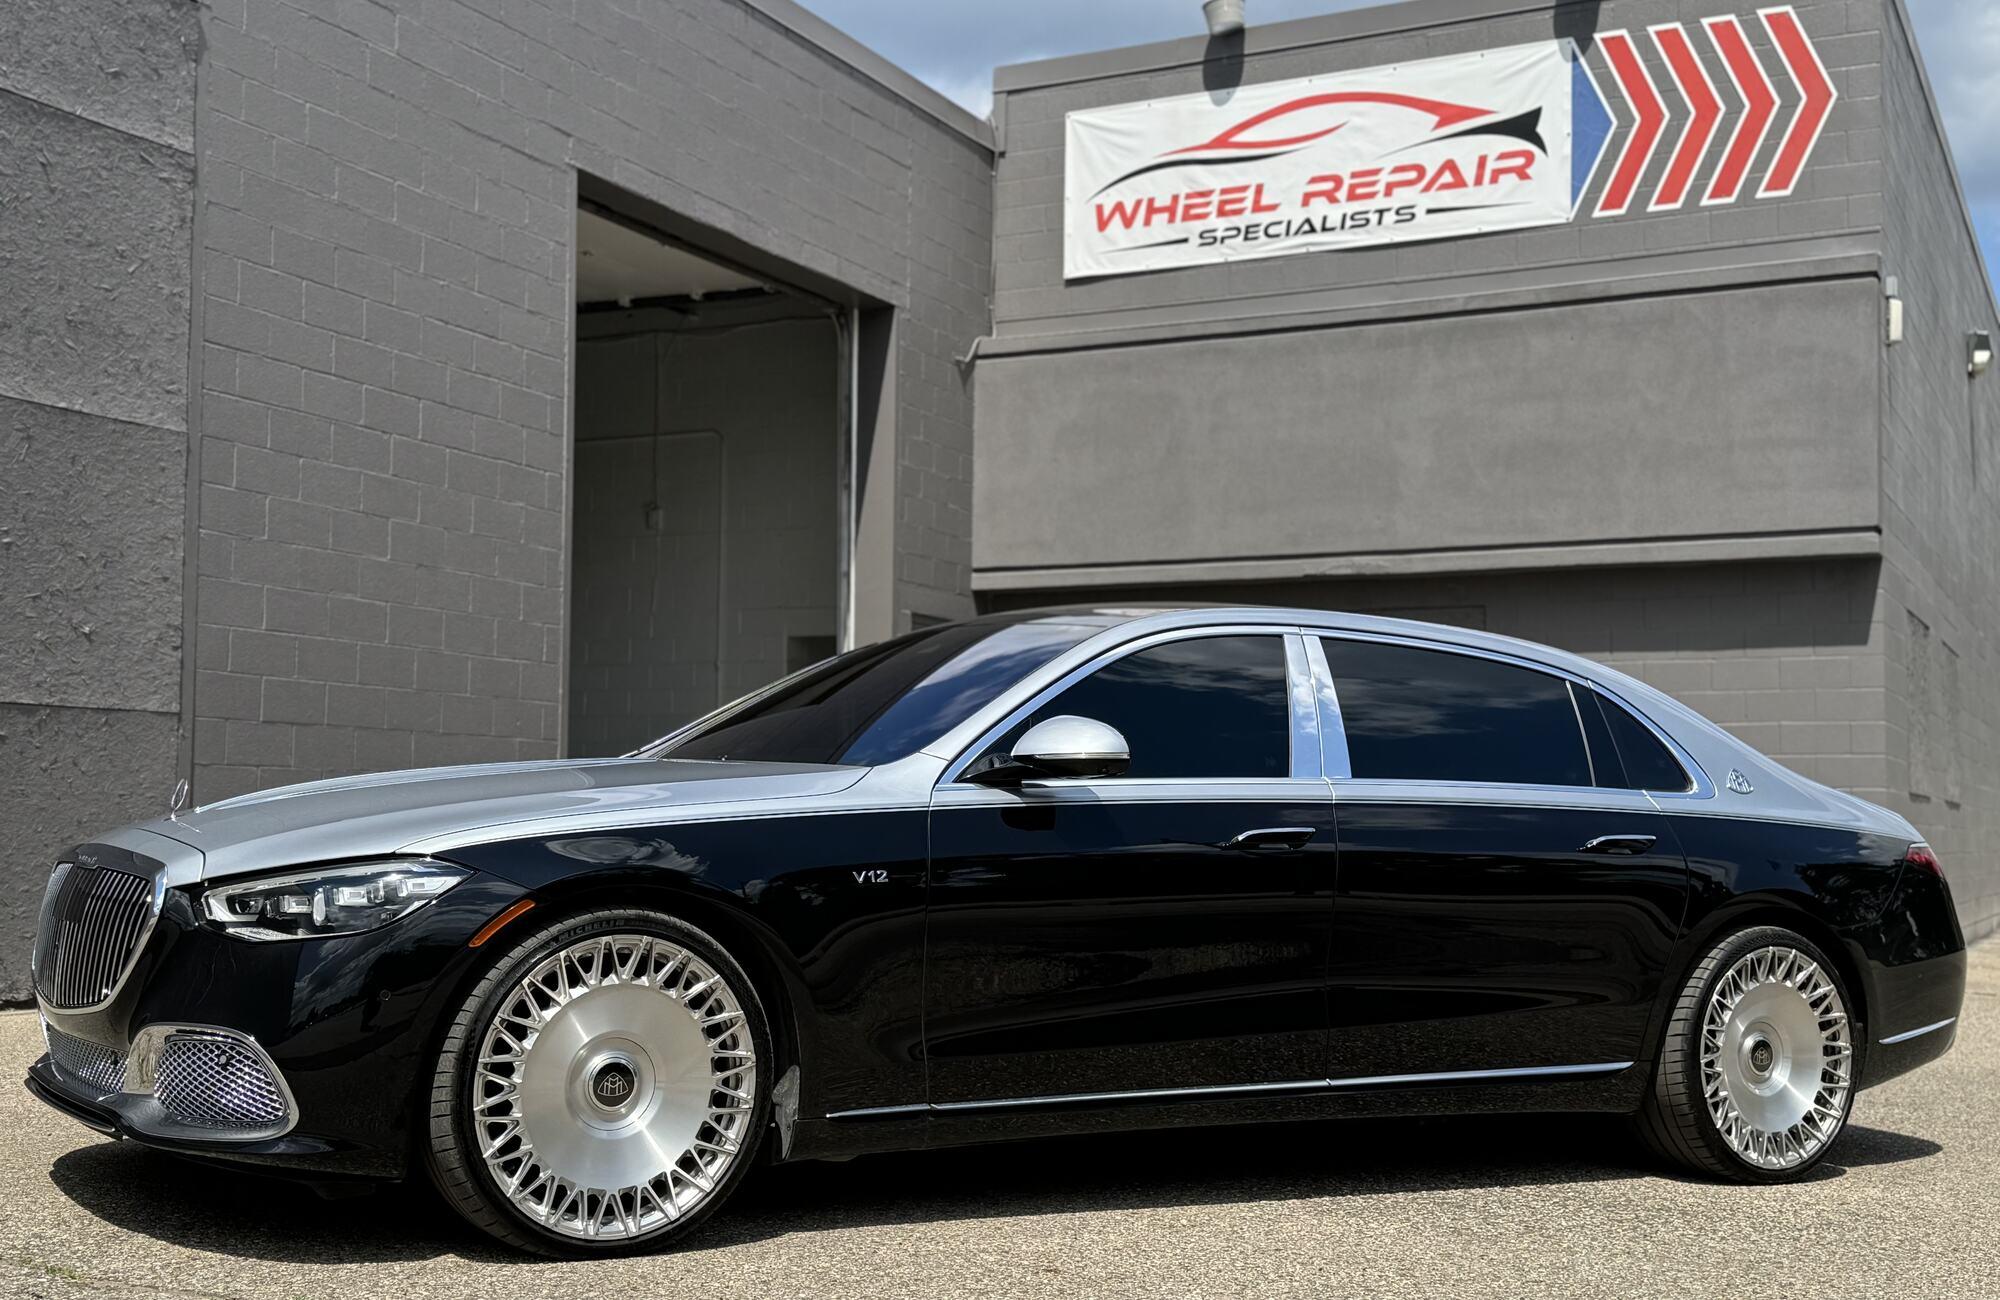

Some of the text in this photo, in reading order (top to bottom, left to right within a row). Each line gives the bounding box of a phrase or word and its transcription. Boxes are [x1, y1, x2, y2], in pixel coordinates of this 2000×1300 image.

[1095, 149, 1535, 233] WHEEL REPAIR
[1198, 205, 1416, 247] SPECIALISTS
[852, 869, 889, 884] V12
